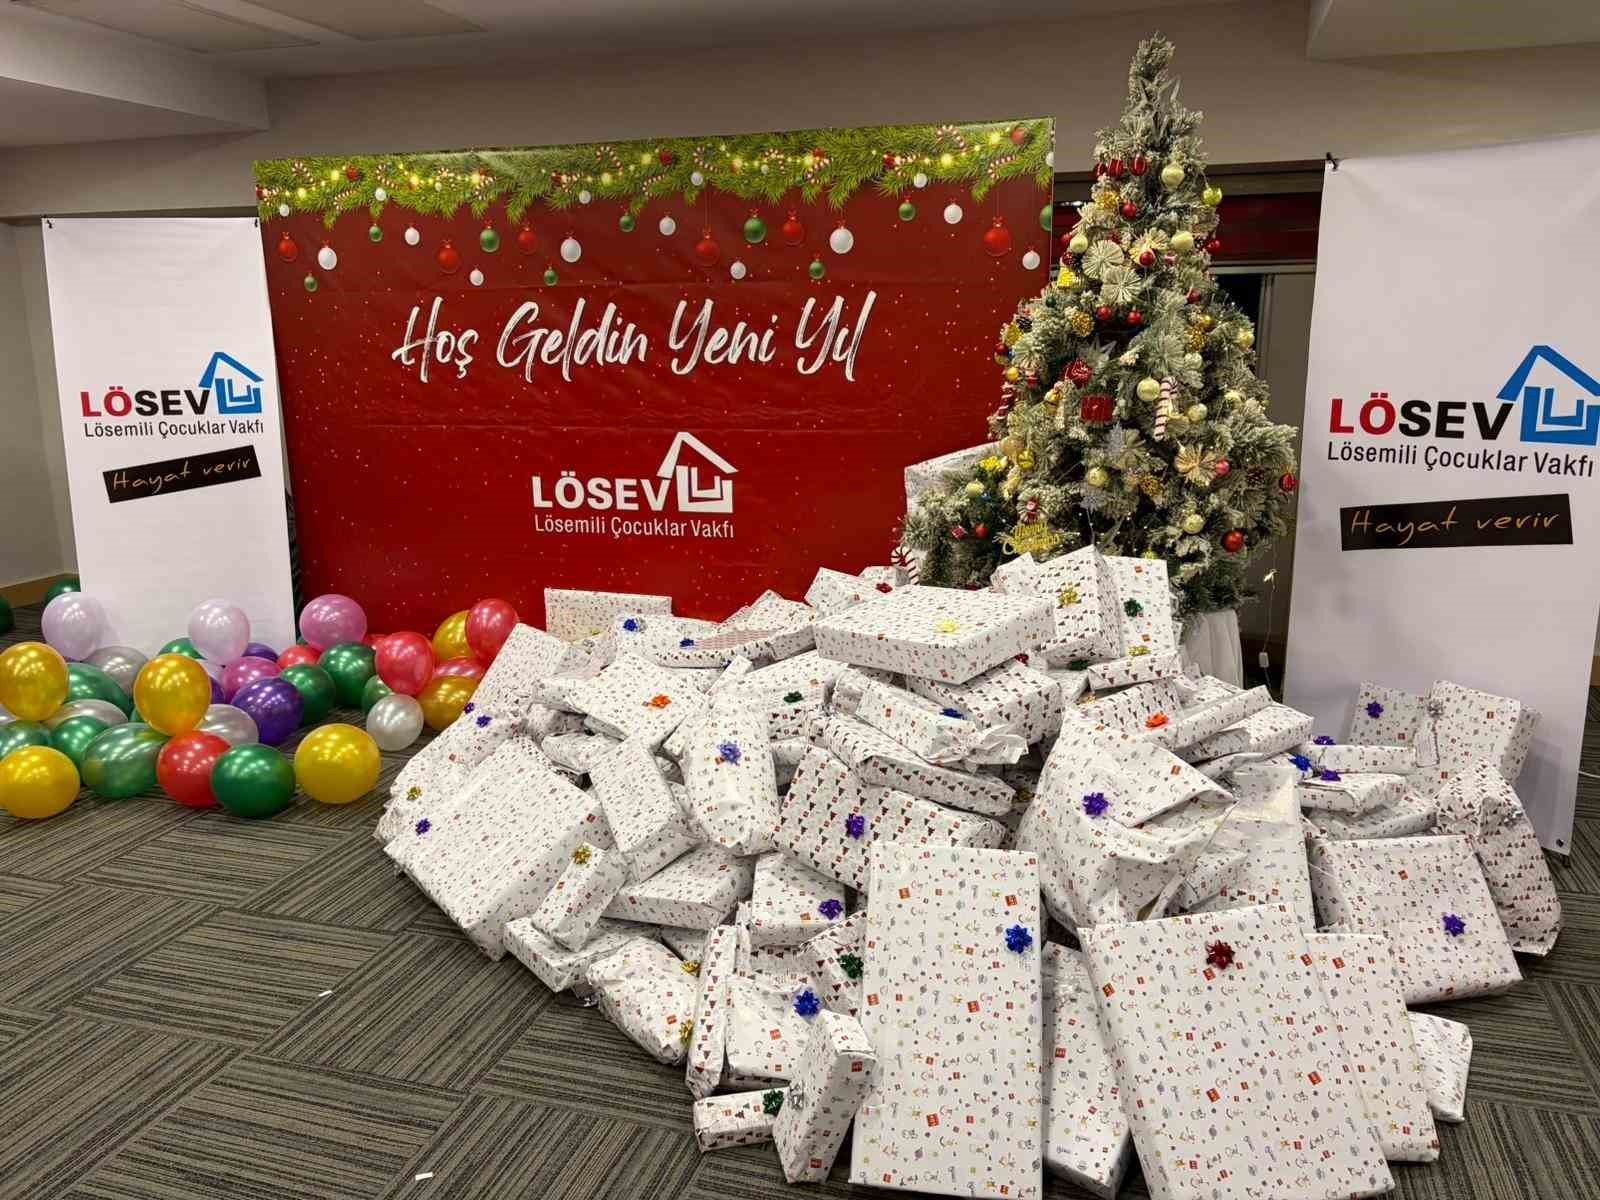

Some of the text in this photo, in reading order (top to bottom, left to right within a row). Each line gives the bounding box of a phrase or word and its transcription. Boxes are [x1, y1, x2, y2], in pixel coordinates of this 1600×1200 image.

[391, 290, 877, 383] Hoş Geldin Yeni Yıl
[80, 386, 210, 417] LÖSEV
[1329, 392, 1514, 441] LÖSEV
[84, 419, 264, 439] Lösemili Çocuklar Vakfı
[113, 457, 250, 495] Hayat verir
[1327, 441, 1594, 478] Lösemili Çocuklar Vakfı
[532, 471, 671, 511] LÖSEV
[534, 514, 735, 539] Lösemili Çocuklar Vakfı
[1350, 506, 1560, 546] Hayat verir
